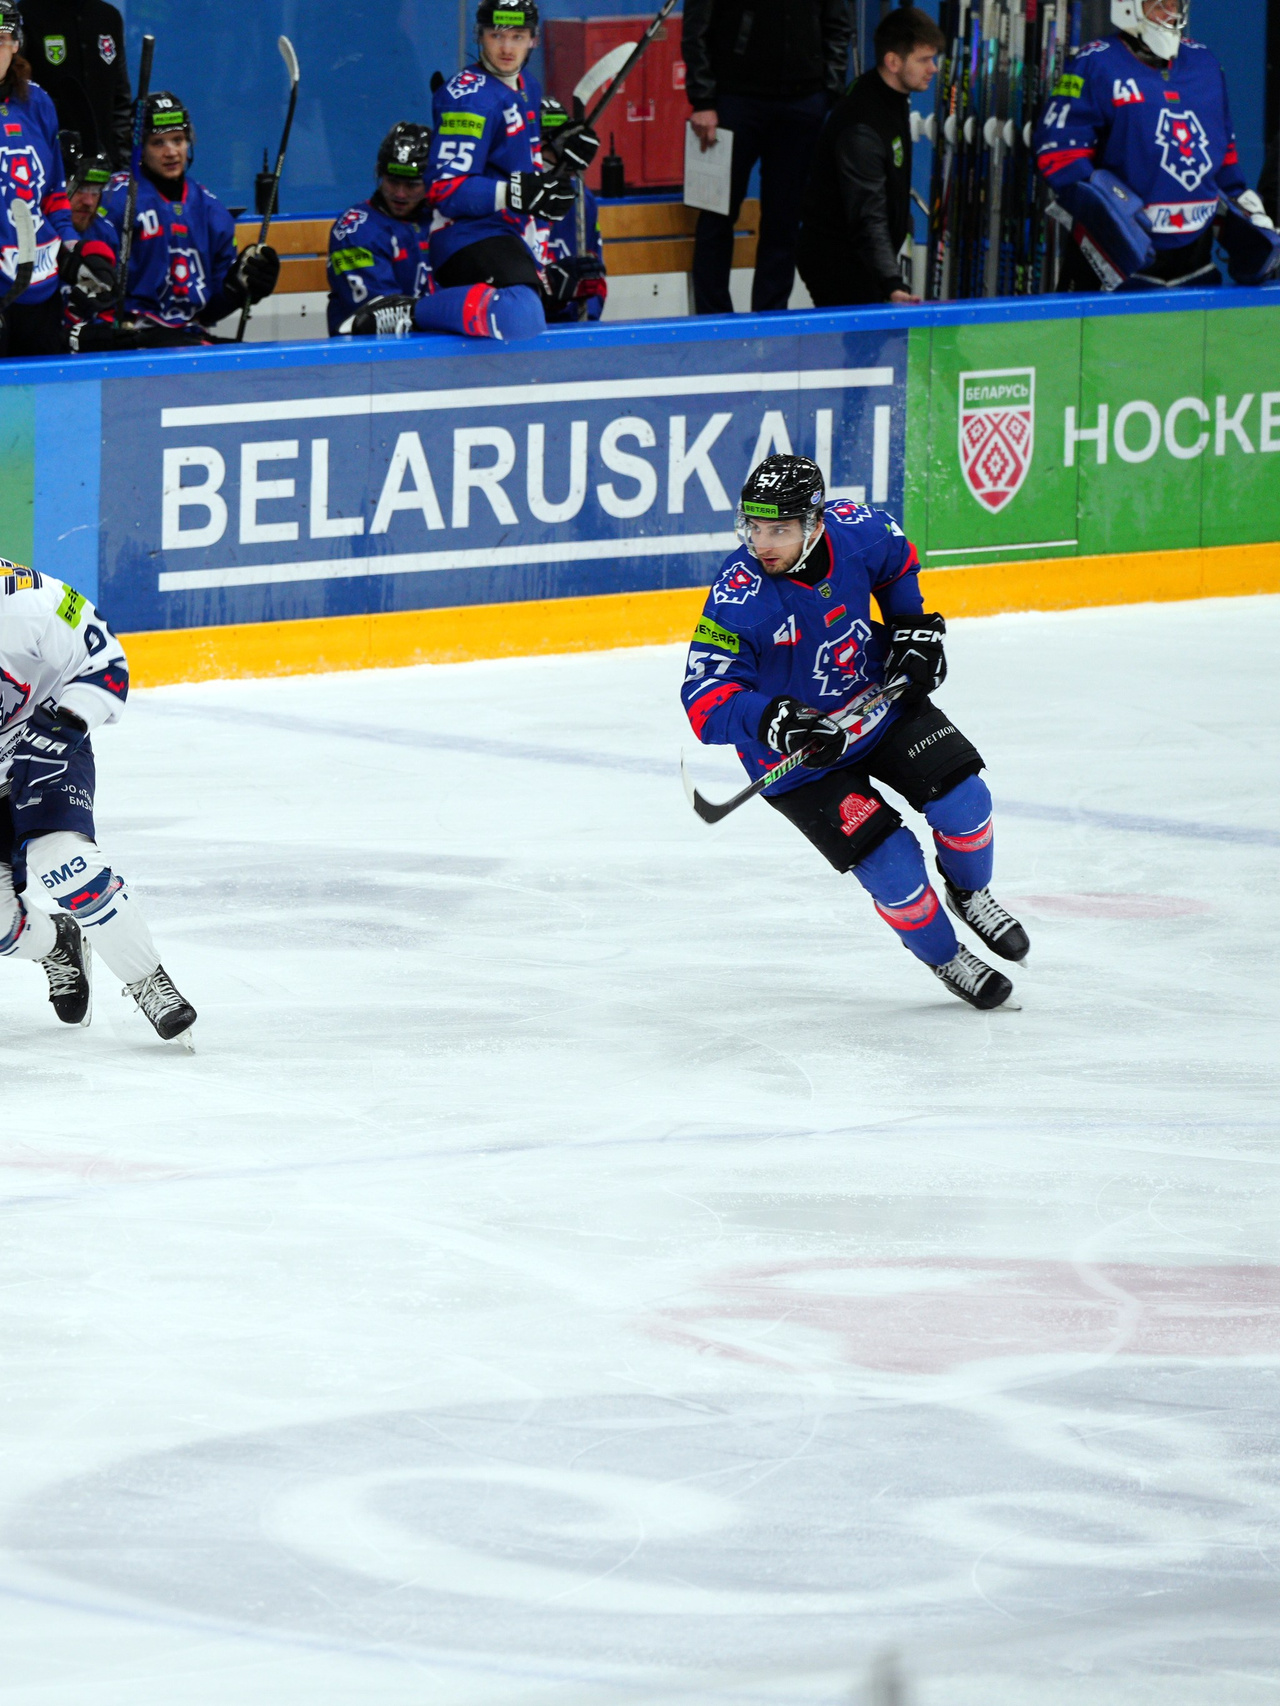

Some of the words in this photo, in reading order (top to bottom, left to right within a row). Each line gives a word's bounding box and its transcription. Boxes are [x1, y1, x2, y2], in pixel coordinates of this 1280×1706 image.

[1113, 78, 1142, 101] 41
[156, 99, 172, 108] 10
[1043, 101, 1071, 129] 41
[441, 118, 483, 132] BETERA
[437, 141, 476, 172] 55
[137, 210, 160, 236] 10
[349, 274, 368, 303] 8
[966, 383, 1030, 402] БЕЛАРУСЬ
[161, 404, 891, 550] BELARUSKALI
[757, 474, 780, 488] 57
[745, 504, 778, 516] BETERA
[893, 630, 946, 642] CCM
[686, 651, 738, 682] 57
[907, 724, 957, 759] #1РЕГИОН
[42, 855, 88, 889] БМЗ
